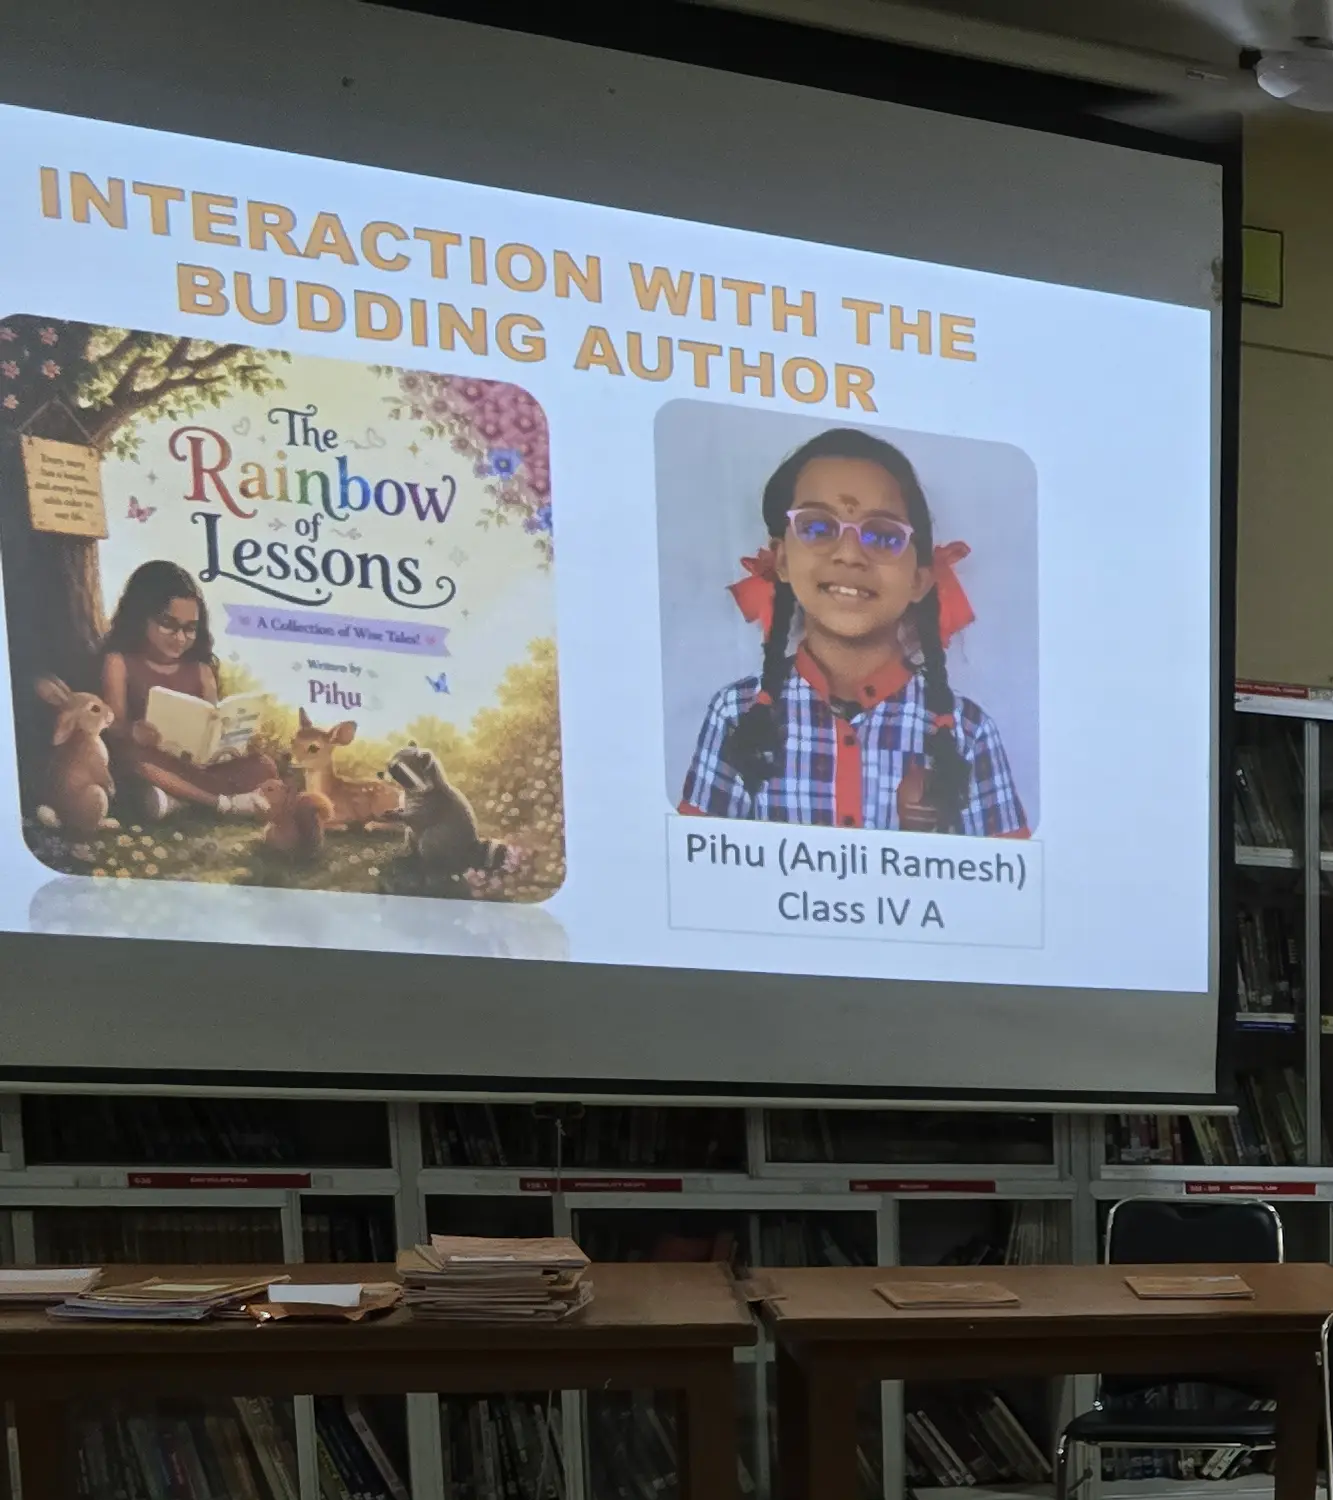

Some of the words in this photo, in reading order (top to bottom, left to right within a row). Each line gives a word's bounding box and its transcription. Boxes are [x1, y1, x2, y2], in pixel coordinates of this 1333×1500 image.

[39, 165, 603, 303] INTERACTION
[628, 261, 817, 338] WITH
[841, 297, 978, 362] THE
[175, 261, 547, 364] BUDDING
[573, 324, 879, 413] AUTHOR
[267, 403, 339, 453] The
[168, 425, 457, 523] Rainbow
[294, 511, 324, 543] of
[190, 510, 457, 610] Lessons
[256, 616, 268, 629] A
[270, 619, 335, 638] Collection
[337, 622, 350, 637] of
[353, 625, 384, 643] Wise
[307, 678, 362, 710] Pihu
[350, 664, 363, 677] by
[686, 833, 765, 868] Pihu
[778, 837, 868, 880] (Anjli
[880, 847, 1026, 891] Ramesh)
[777, 890, 866, 925] Class
[877, 897, 911, 926] IV
[920, 899, 945, 929] A
